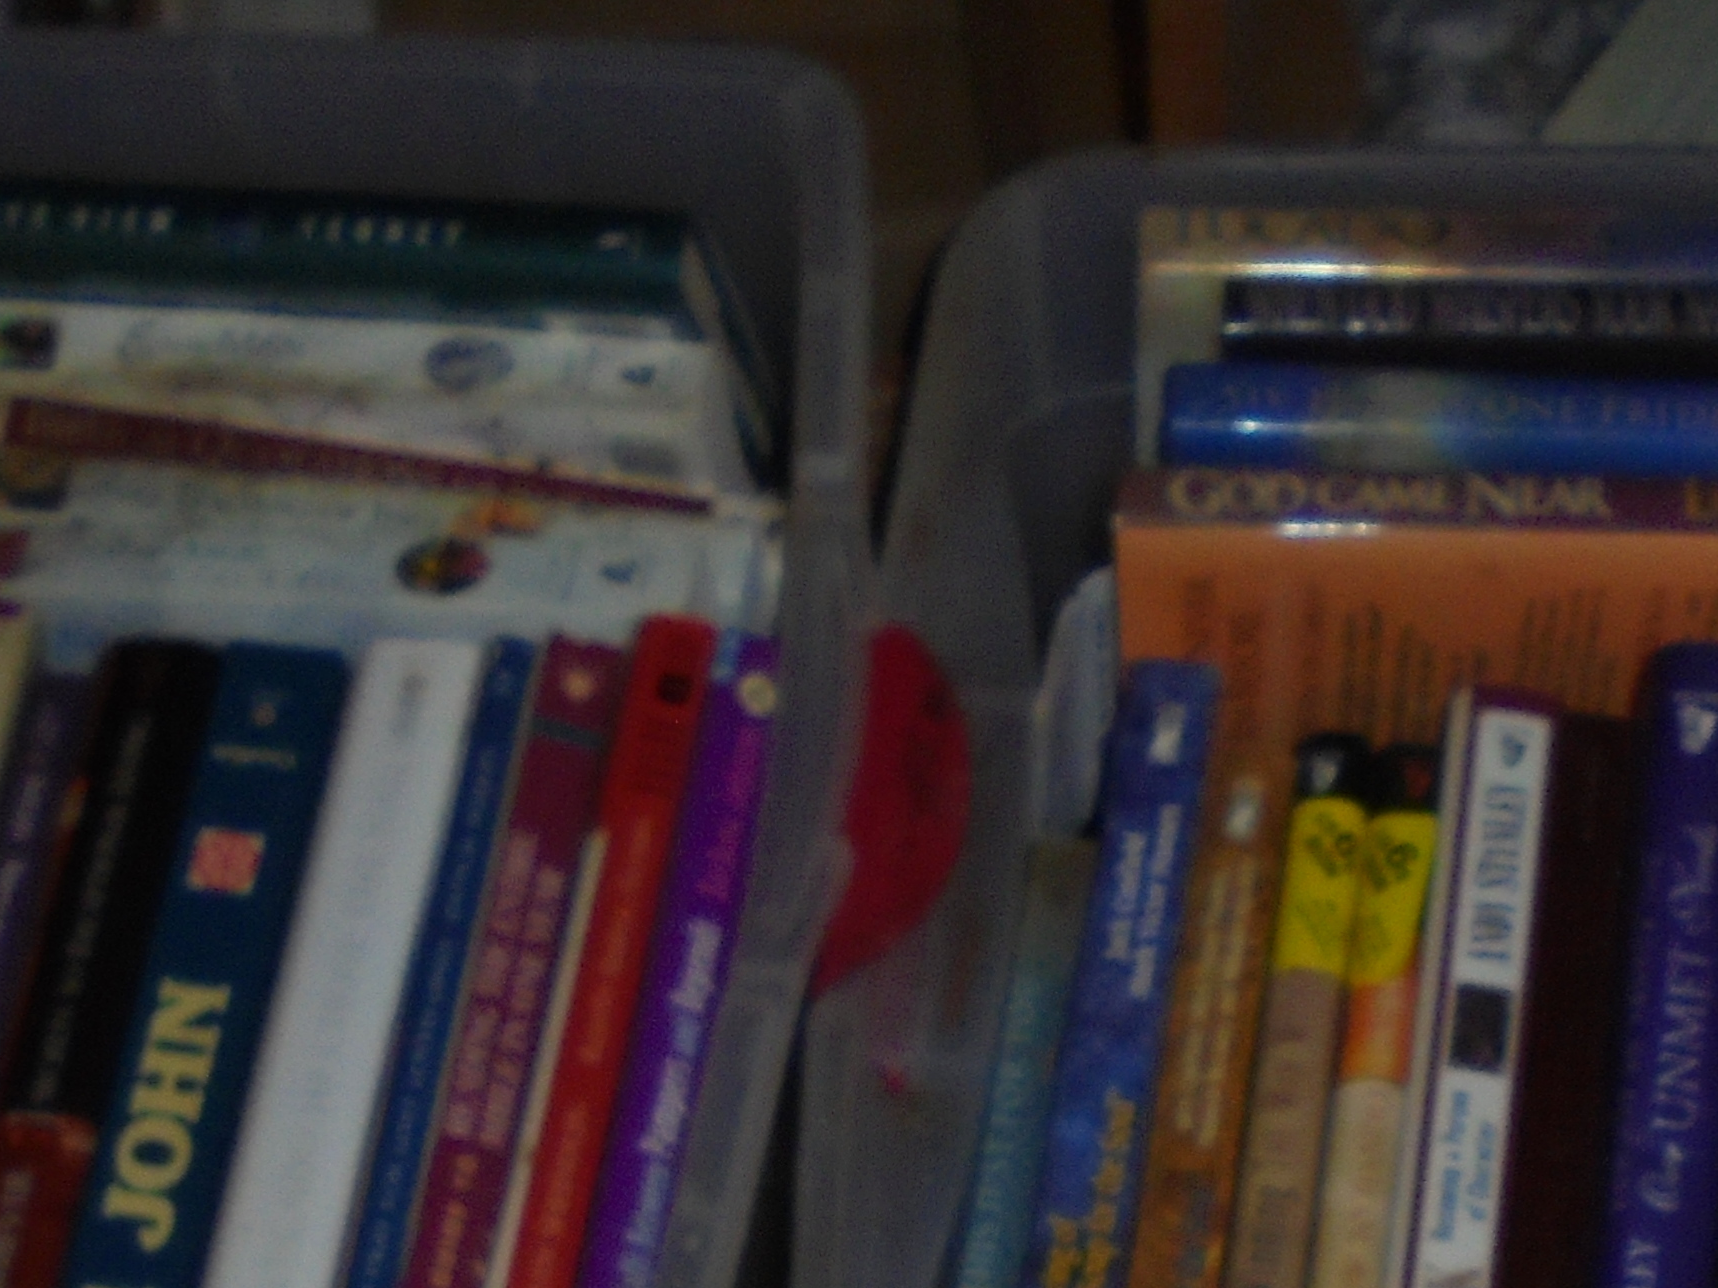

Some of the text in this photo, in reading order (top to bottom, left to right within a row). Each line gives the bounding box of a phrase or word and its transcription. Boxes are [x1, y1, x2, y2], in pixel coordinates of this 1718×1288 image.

[1167, 471, 1306, 515] GOD
[1314, 476, 1450, 513] CAME
[1463, 475, 1610, 518] NEAR
[102, 976, 233, 1254] JOHN
[1646, 939, 1717, 1136] UNMET
